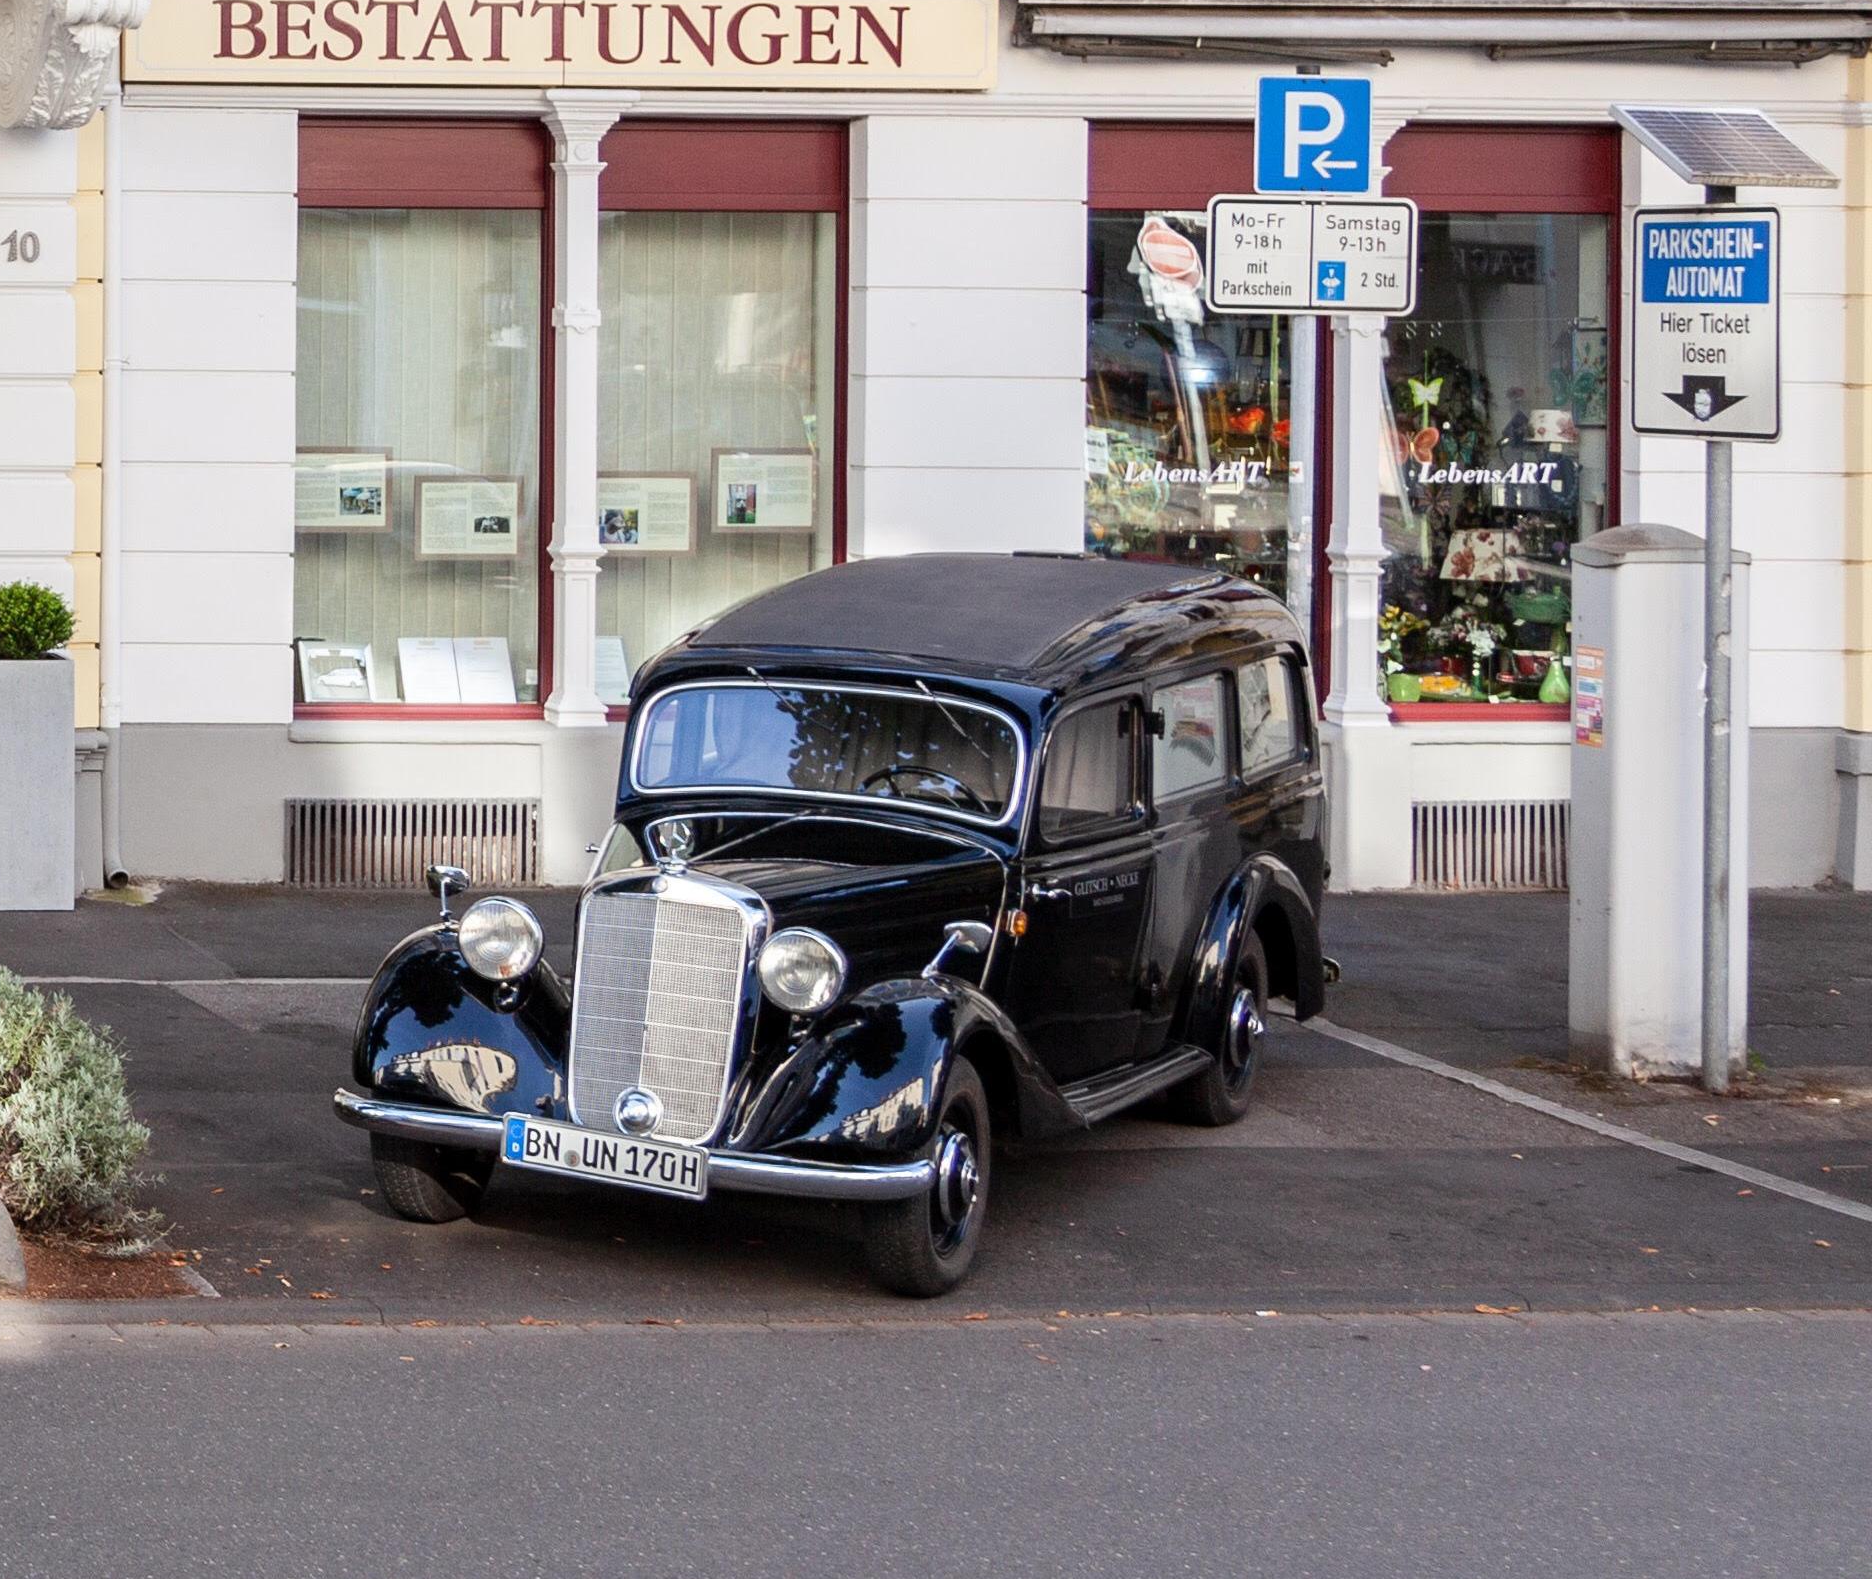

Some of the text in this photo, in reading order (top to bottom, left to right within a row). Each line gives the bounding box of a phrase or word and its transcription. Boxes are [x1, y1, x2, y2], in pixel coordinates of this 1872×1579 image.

[1283, 91, 1345, 178] P
[1231, 212, 1286, 228] Mo-Fr
[1326, 215, 1401, 235] Samstag
[0, 229, 40, 263] 10
[1649, 228, 1764, 260] PARKSCHEIN-
[1247, 259, 1268, 274] mit
[1221, 280, 1292, 296] Parkschein
[1361, 272, 1399, 288] 2 Std.
[1665, 266, 1745, 298] AUTOMAT
[1660, 312, 1750, 334] Hier Ticket
[1682, 342, 1726, 364] lösen
[1124, 461, 1265, 483] LebensART
[1418, 461, 1557, 484] LebensART
[526, 1128, 561, 1161] BN
[582, 1137, 618, 1172] UN
[624, 1146, 698, 1187] 170H
